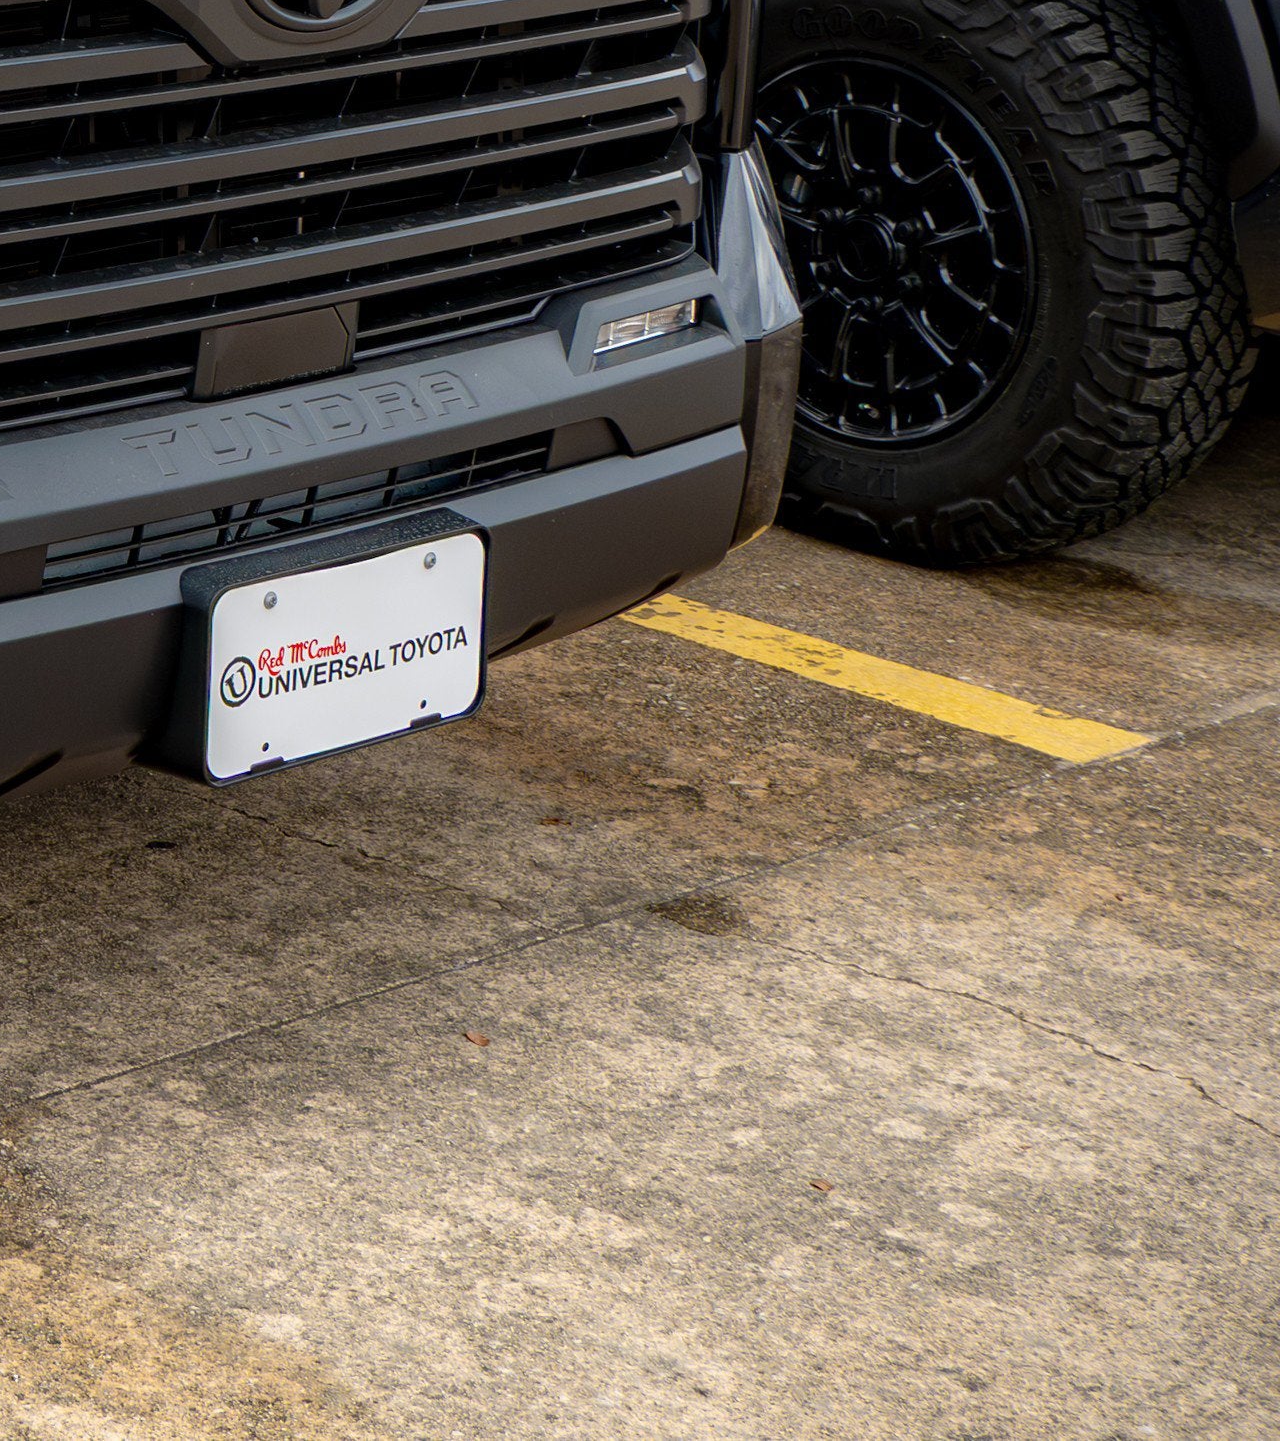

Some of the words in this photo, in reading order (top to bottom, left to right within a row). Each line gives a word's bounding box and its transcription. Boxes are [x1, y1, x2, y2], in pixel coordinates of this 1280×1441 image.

[119, 369, 480, 476] TUNDRA
[258, 648, 284, 676] Red
[288, 634, 347, 662] McCombs
[258, 649, 386, 699] UNIVERSAL
[389, 625, 469, 667] TOYOTA
